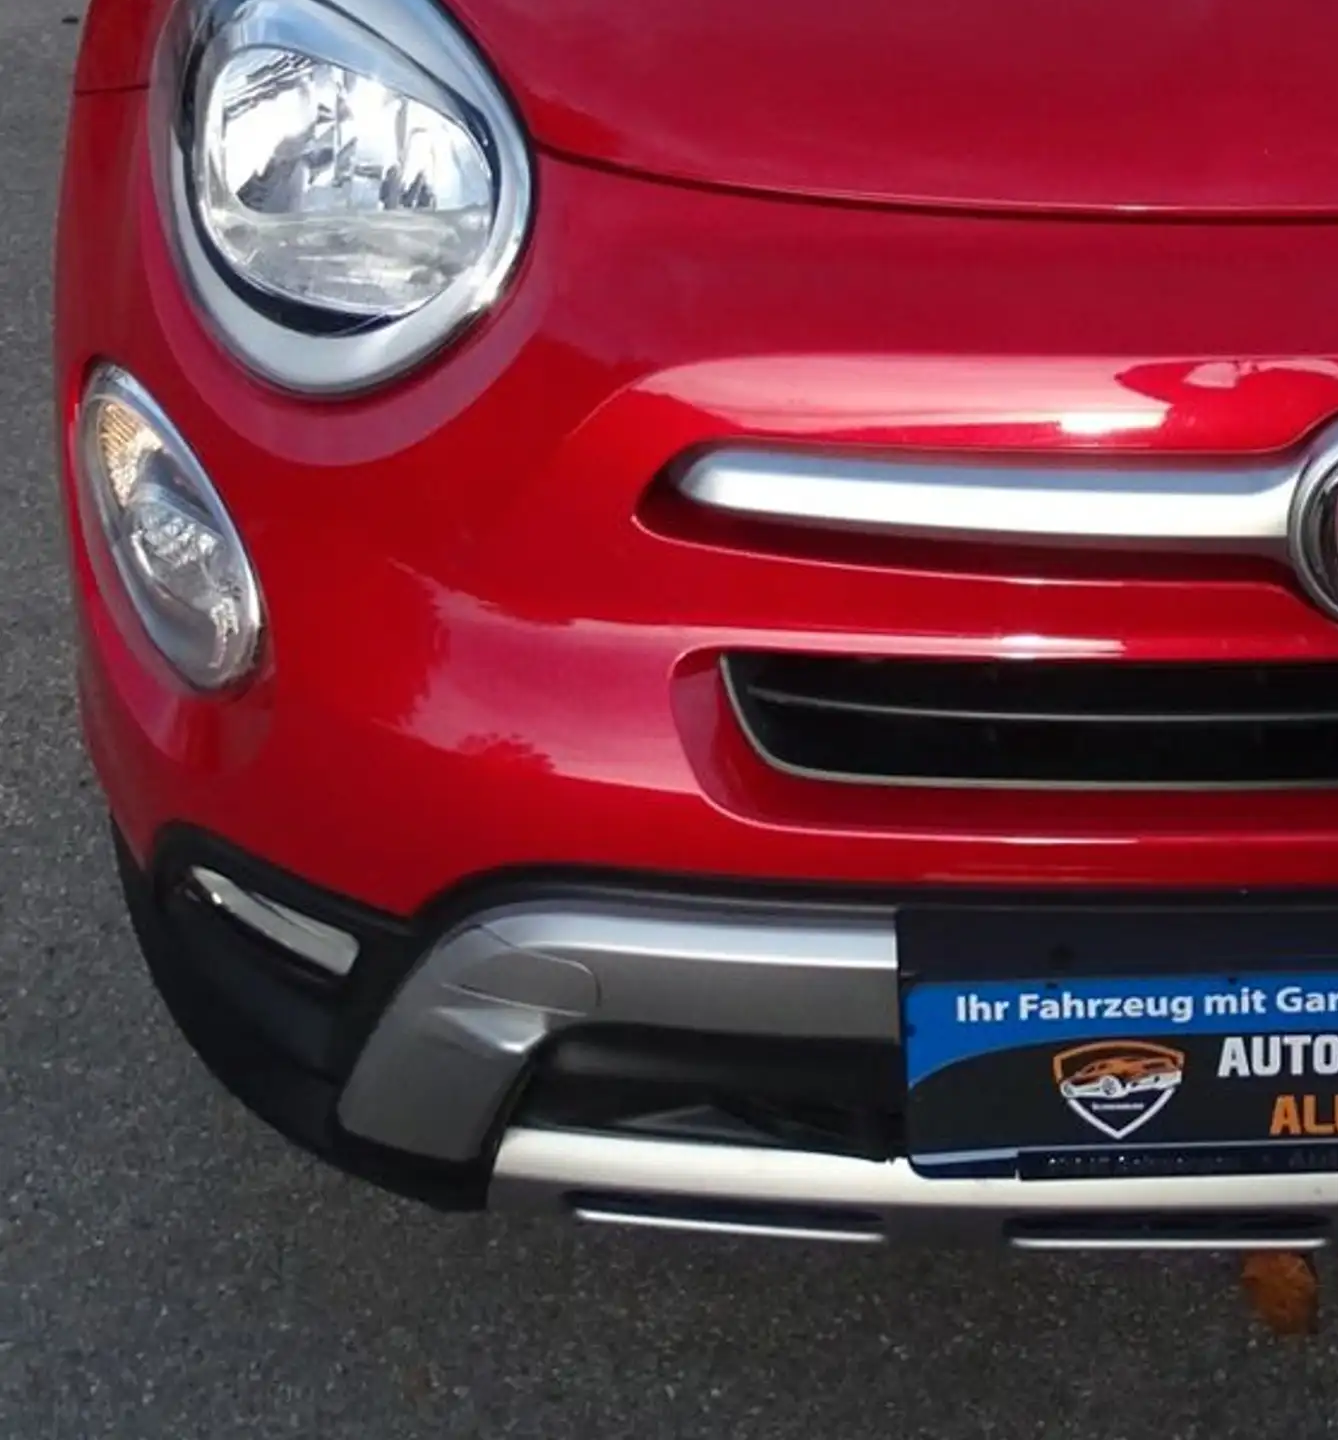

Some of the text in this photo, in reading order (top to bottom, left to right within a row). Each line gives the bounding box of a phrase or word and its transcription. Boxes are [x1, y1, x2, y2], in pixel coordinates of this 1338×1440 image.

[956, 993, 1010, 1022] Ihr
[1018, 990, 1194, 1023] Fahrzeug
[1203, 986, 1267, 1016] mit
